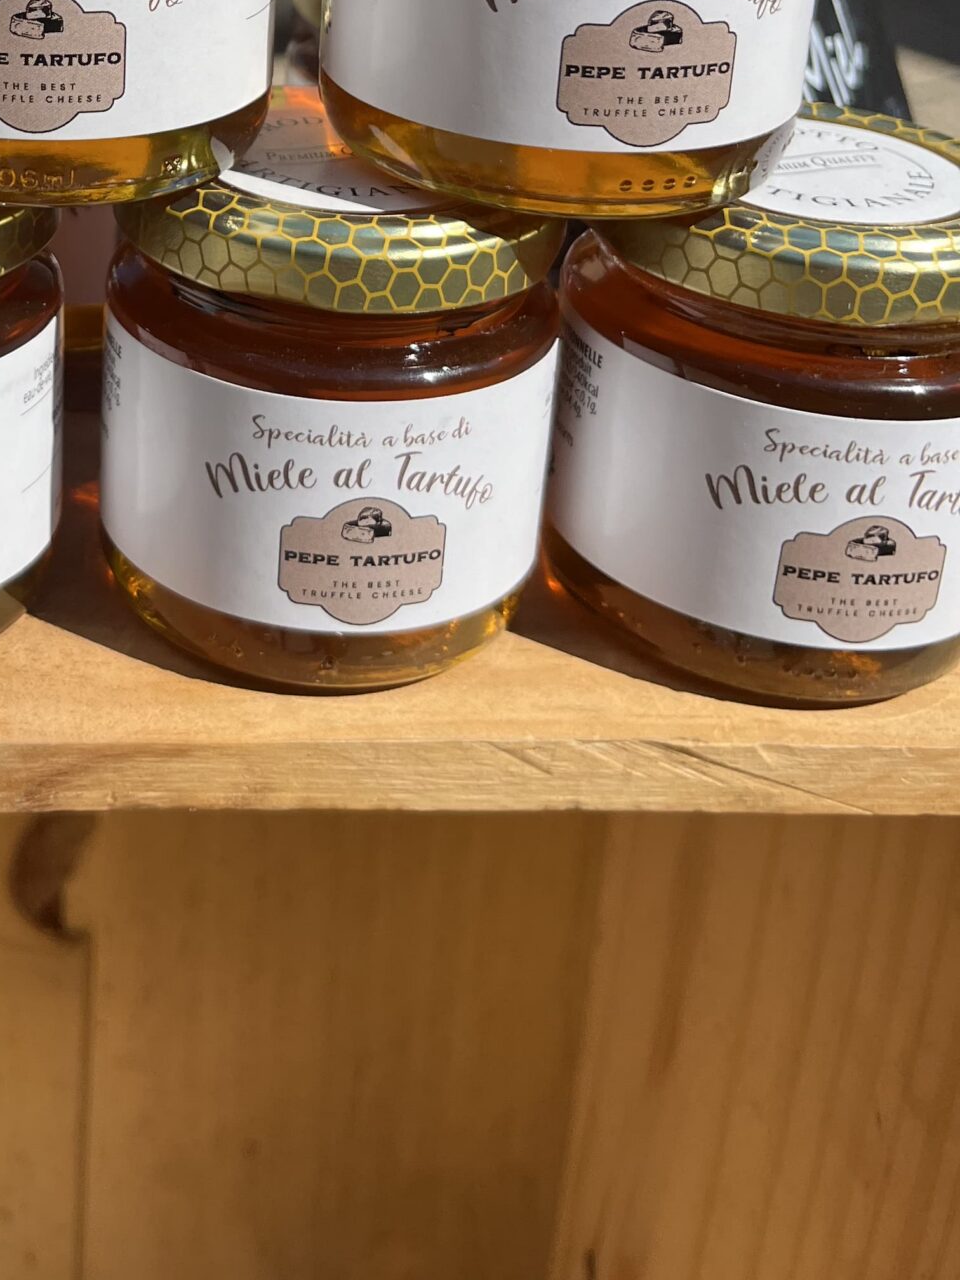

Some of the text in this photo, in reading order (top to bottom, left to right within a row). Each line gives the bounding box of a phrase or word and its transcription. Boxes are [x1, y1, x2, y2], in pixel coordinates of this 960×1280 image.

[20, 51, 122, 67] TARTUFO
[565, 61, 731, 80] PEPE TARTUFO
[3, 81, 77, 91] THE BEST
[45, 93, 103, 104] CHEESE
[617, 95, 689, 105] THE BEST
[583, 105, 710, 118] TRUFFLE CHEESE
[767, 170, 935, 208] TIGIANALE
[251, 414, 472, 448] Specialità a base di
[764, 428, 888, 465] Specialità
[899, 453, 915, 466] a
[205, 451, 493, 510] Miele al Tartufo
[705, 465, 960, 515] Miele al Tart
[284, 549, 441, 567] PEPE TARTUFO
[782, 565, 939, 585] PEPE TARTUFO
[333, 579, 400, 589] THE BEST
[301, 587, 423, 599] TRUFFLE CHEESE
[831, 597, 898, 607] THE BEST
[797, 604, 917, 617] TRUFFLE CHEESE
